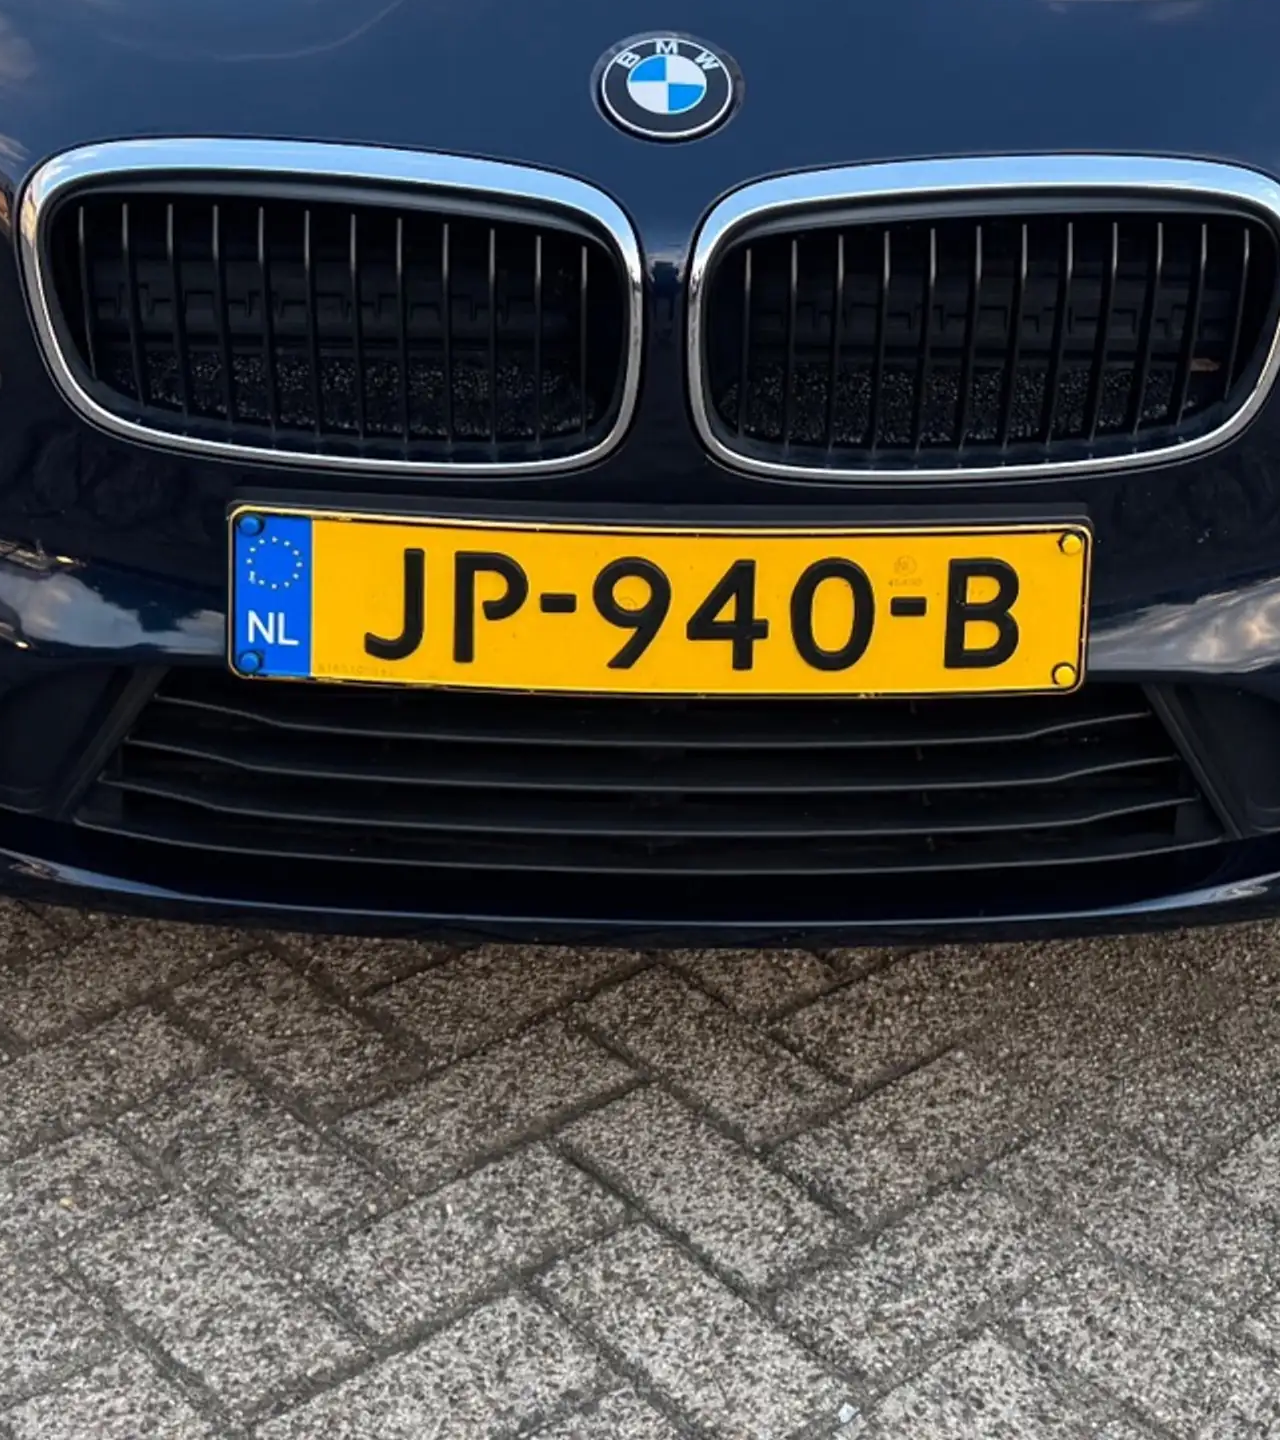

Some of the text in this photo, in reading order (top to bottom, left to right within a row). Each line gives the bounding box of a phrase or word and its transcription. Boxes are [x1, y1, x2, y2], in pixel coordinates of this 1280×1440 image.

[616, 40, 720, 70] BMW
[363, 547, 1021, 671] JP-940-B
[247, 610, 299, 648] NL
